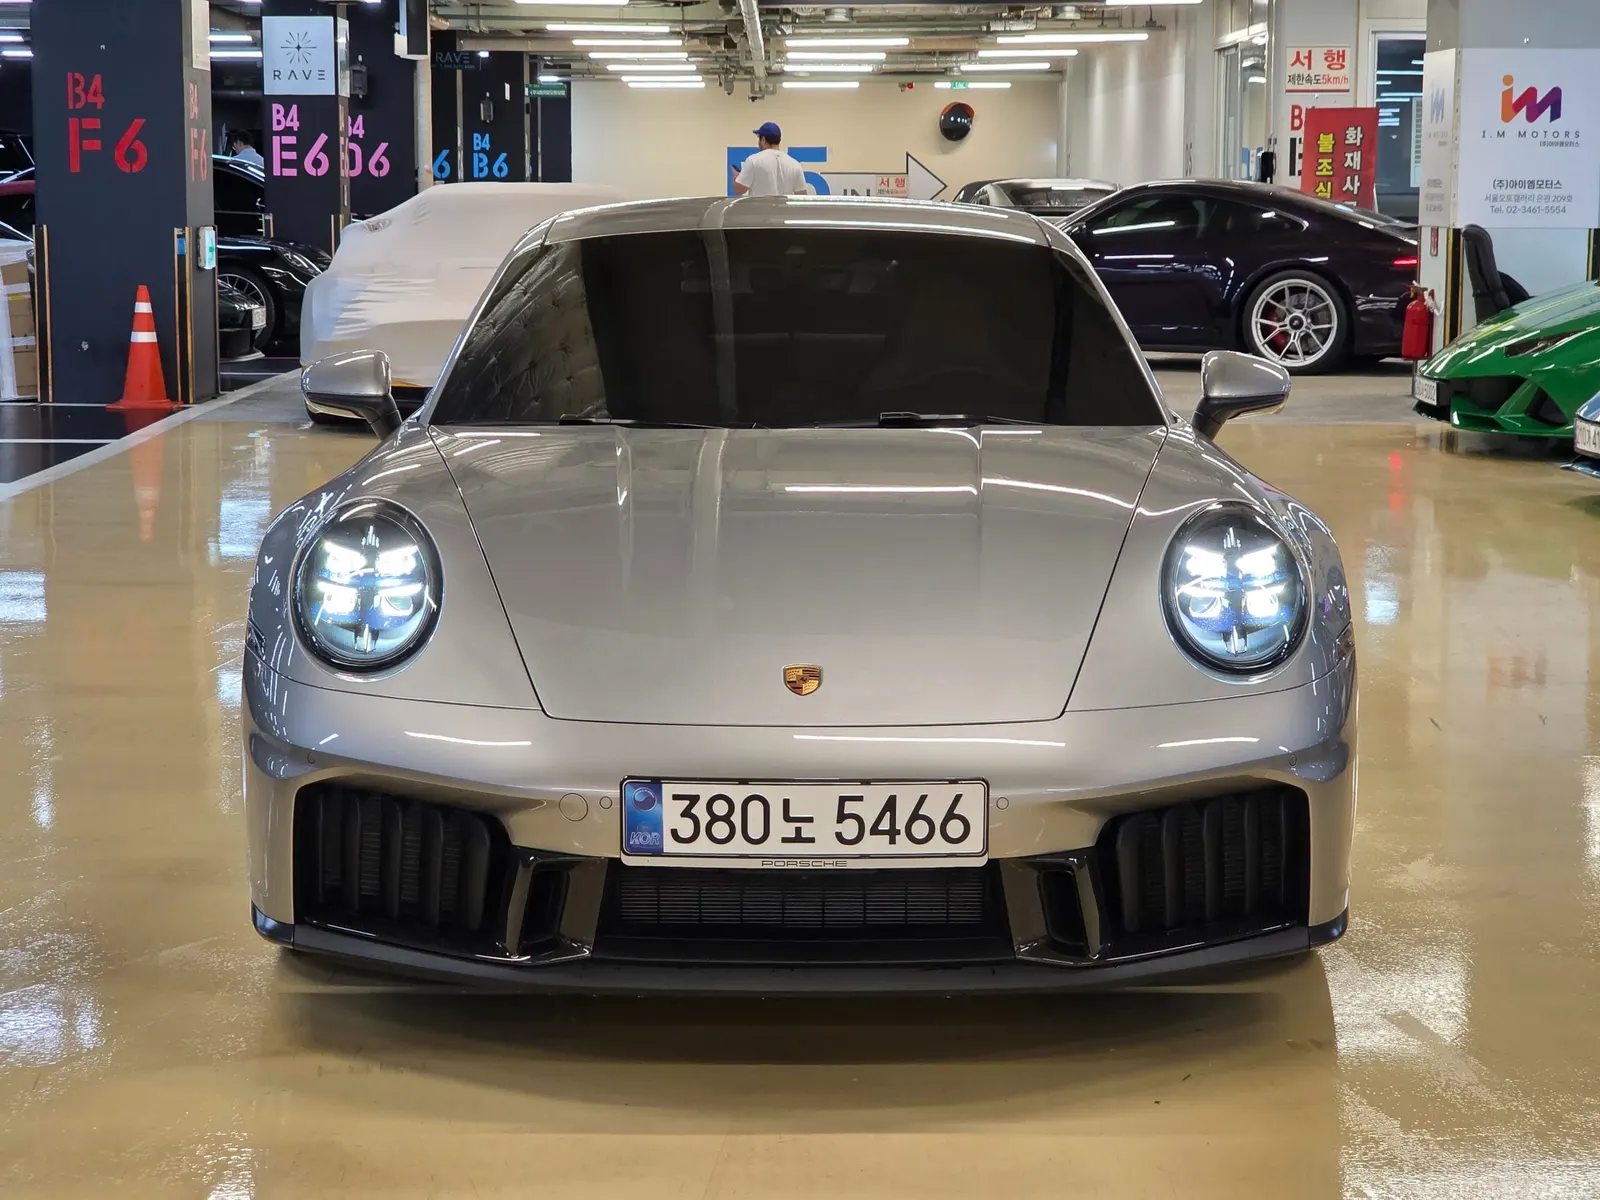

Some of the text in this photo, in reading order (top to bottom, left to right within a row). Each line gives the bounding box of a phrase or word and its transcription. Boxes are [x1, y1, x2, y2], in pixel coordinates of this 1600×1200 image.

[273, 69, 326, 80] RAVE
[67, 72, 105, 109] B4
[271, 103, 300, 131] B4
[472, 132, 491, 151] B4
[1518, 130, 1580, 139] MOTORS
[1342, 126, 1363, 207] 화재사
[1492, 179, 1563, 190] (주)아이엠모터스
[1490, 205, 1567, 214] Tel. 02-3461-5554
[670, 793, 971, 845] 380노 5466
[629, 831, 660, 845] KOR
[761, 860, 848, 868] PORSCHE
